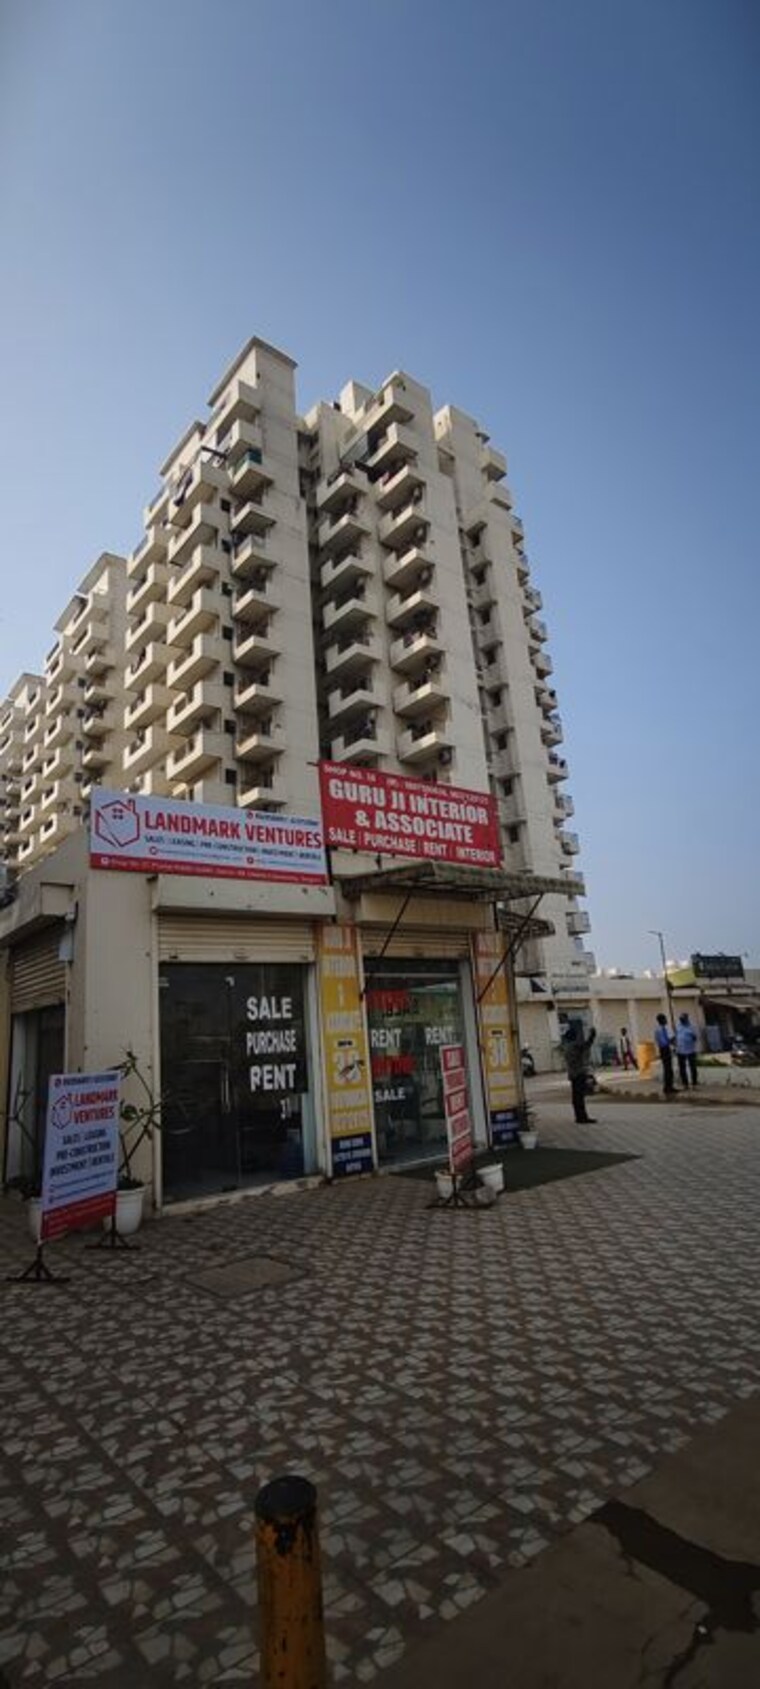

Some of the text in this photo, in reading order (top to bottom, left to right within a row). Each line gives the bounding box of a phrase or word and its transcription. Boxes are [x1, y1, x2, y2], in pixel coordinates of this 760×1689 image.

[328, 778, 386, 807] GURU
[391, 790, 406, 811] JI
[409, 793, 489, 825] INTERIOR
[144, 810, 242, 840] LANDMARK
[244, 823, 323, 849] VENTURES
[354, 810, 474, 843] & ASSOCIATE
[328, 827, 496, 863] SALE PURCHASE RENT INTERIOR
[246, 995, 293, 1021] SALE
[246, 1029, 297, 1056] PURCHASE
[371, 1028, 402, 1048] RENT
[424, 1026, 453, 1045] RENT
[250, 1063, 297, 1093] RENT
[374, 1087, 406, 1103] SALE
[74, 1106, 115, 1124] VENTURES
